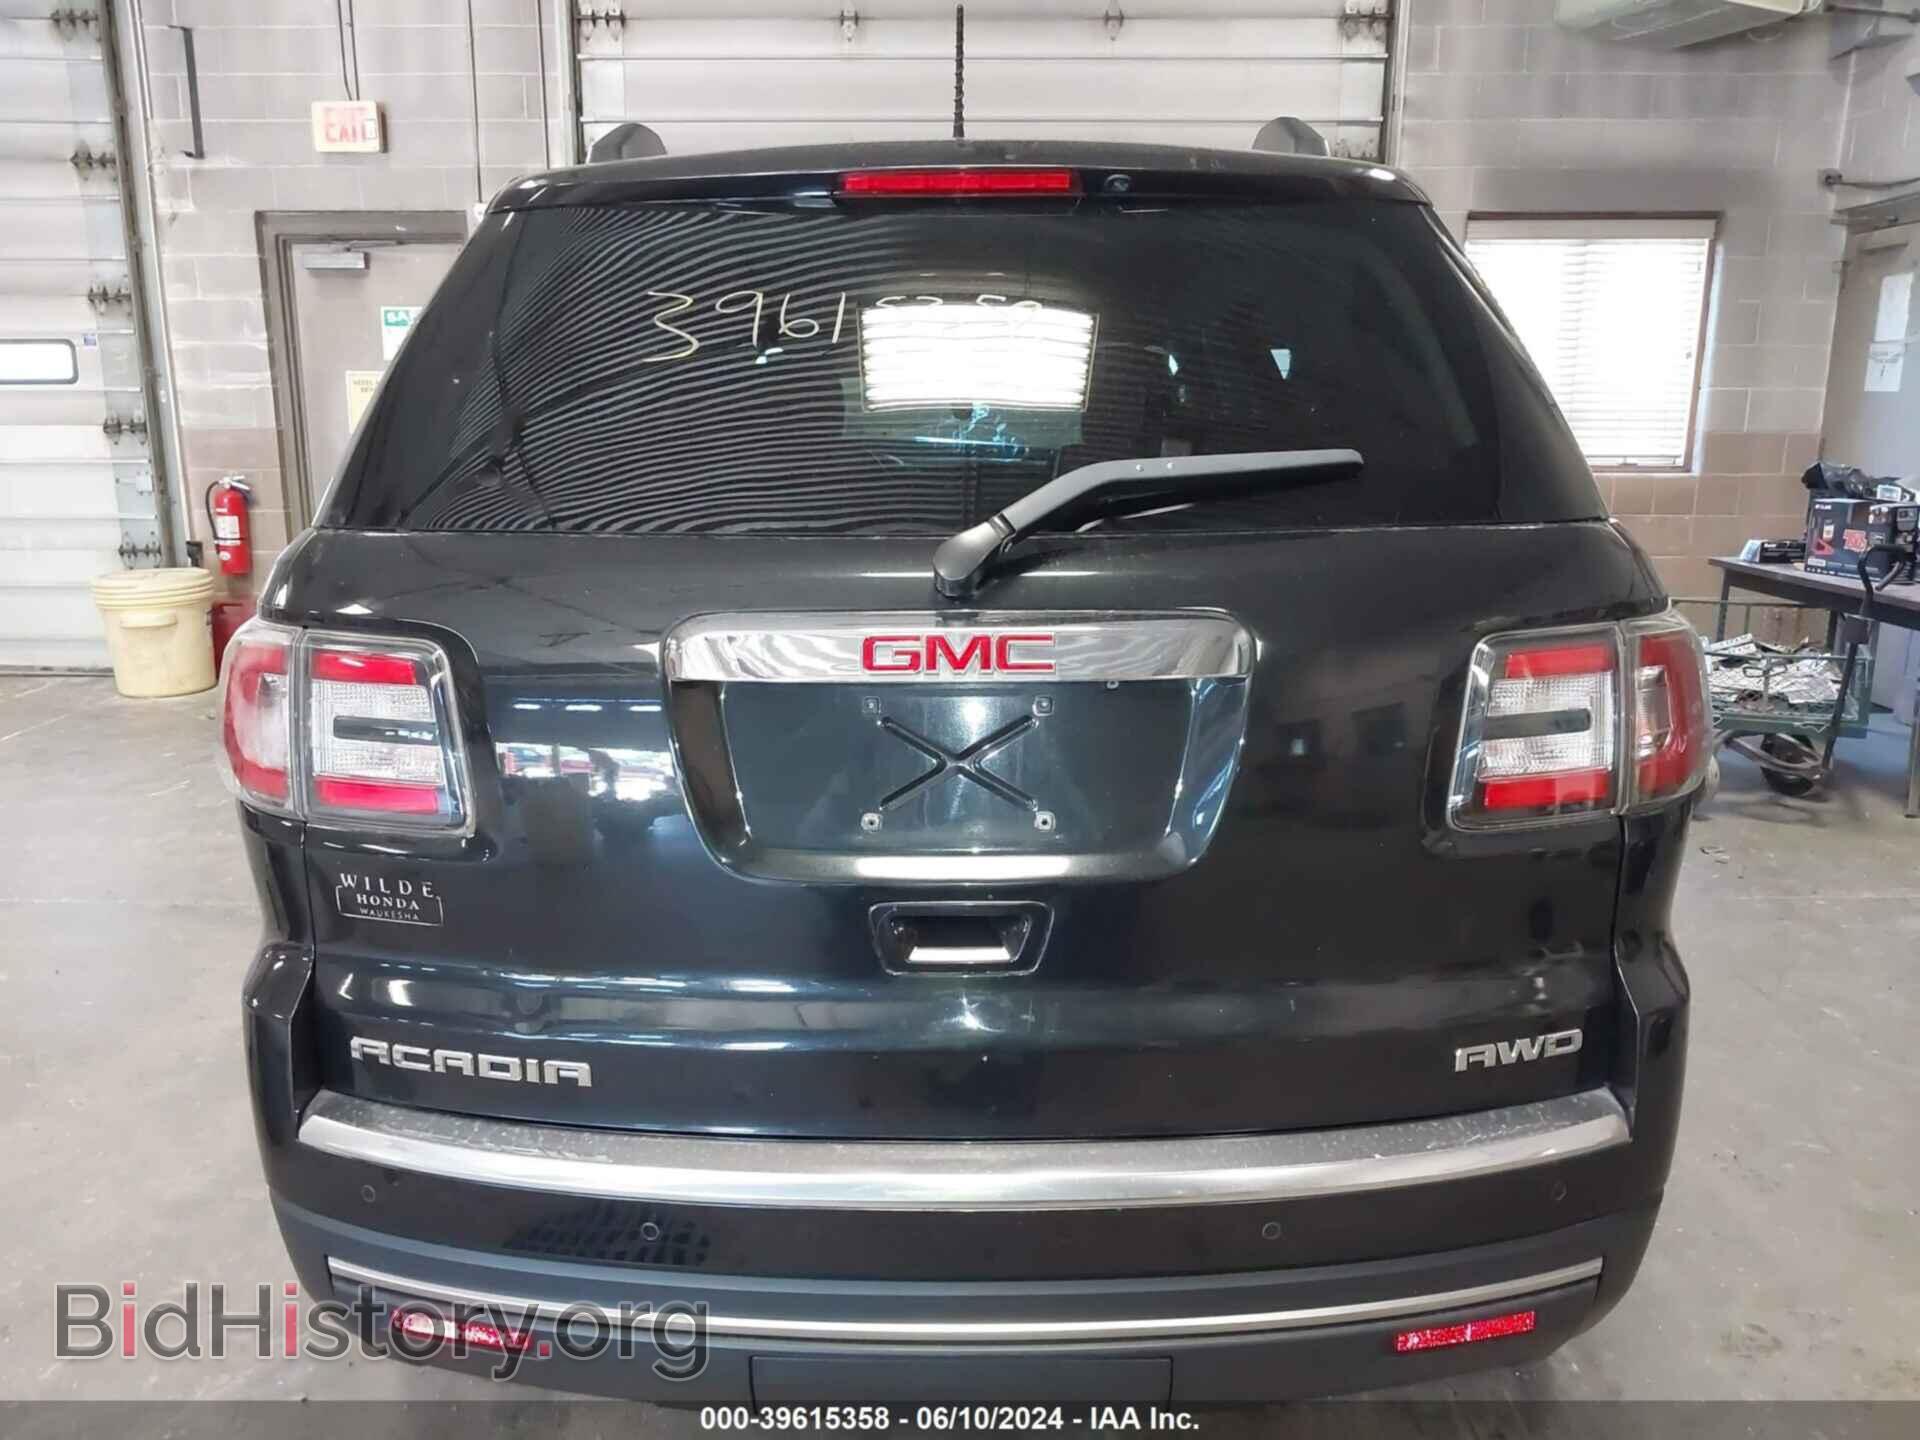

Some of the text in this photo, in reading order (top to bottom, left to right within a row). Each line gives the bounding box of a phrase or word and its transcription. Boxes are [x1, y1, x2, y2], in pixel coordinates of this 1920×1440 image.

[862, 633, 1056, 674] GMC
[340, 873, 434, 898] WILDE
[356, 893, 420, 911] HONDA
[359, 907, 420, 921] WAUKESHA
[350, 1035, 592, 1088] ACADIA
[1454, 1028, 1584, 1073] AWD
